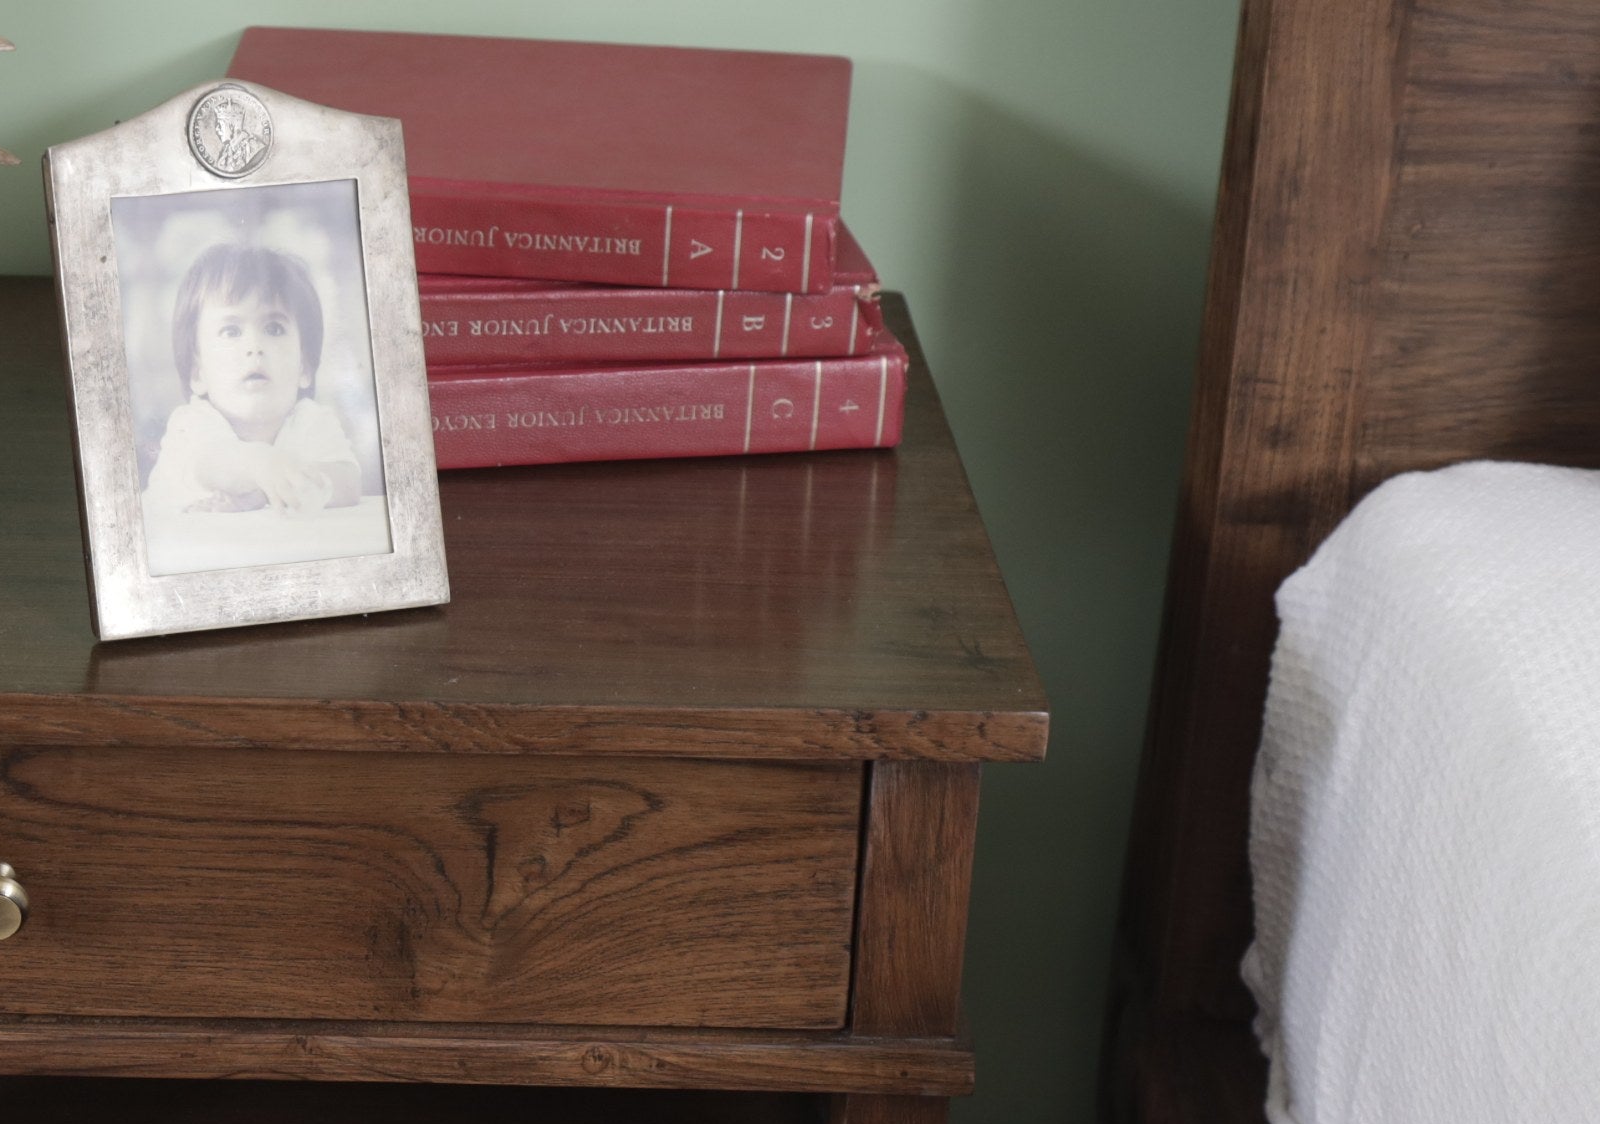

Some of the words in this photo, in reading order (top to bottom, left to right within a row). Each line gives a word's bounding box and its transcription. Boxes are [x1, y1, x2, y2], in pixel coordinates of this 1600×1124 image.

[413, 226, 500, 247] JUNIOR
[504, 232, 642, 255] BRITANNICA
[689, 239, 714, 259] A
[761, 247, 785, 261] 2
[469, 314, 554, 336] JUNIOR
[559, 316, 693, 334] BRITANNICA
[742, 315, 765, 332] B
[810, 316, 834, 330] 3
[593, 404, 725, 426] BRITANNICA
[772, 398, 794, 419] C
[839, 400, 860, 414] 4
[508, 407, 586, 429] JUNIOR
